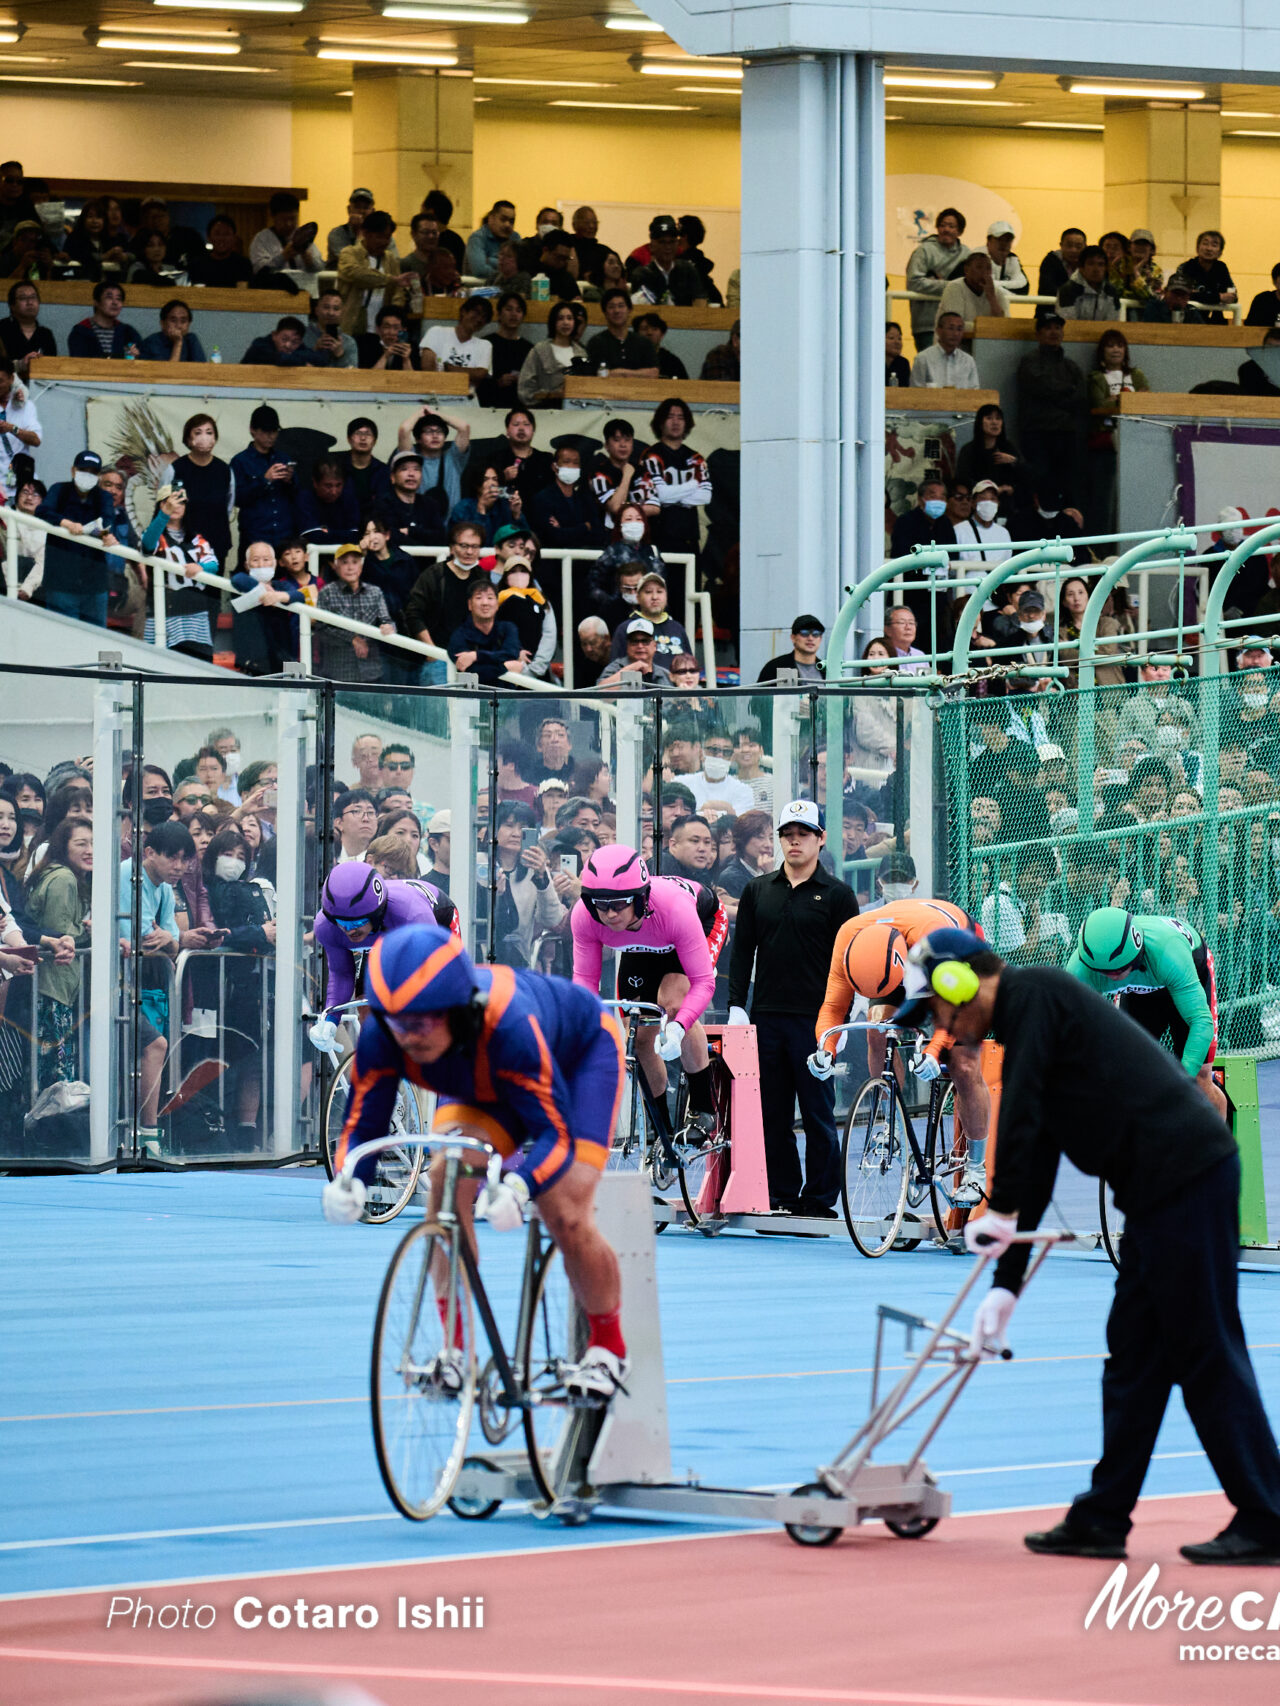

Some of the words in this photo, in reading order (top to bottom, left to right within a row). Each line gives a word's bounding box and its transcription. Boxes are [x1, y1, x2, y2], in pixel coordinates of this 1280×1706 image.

[638, 858, 648, 882] 8
[372, 876, 384, 906] 9
[1131, 925, 1143, 950] 6
